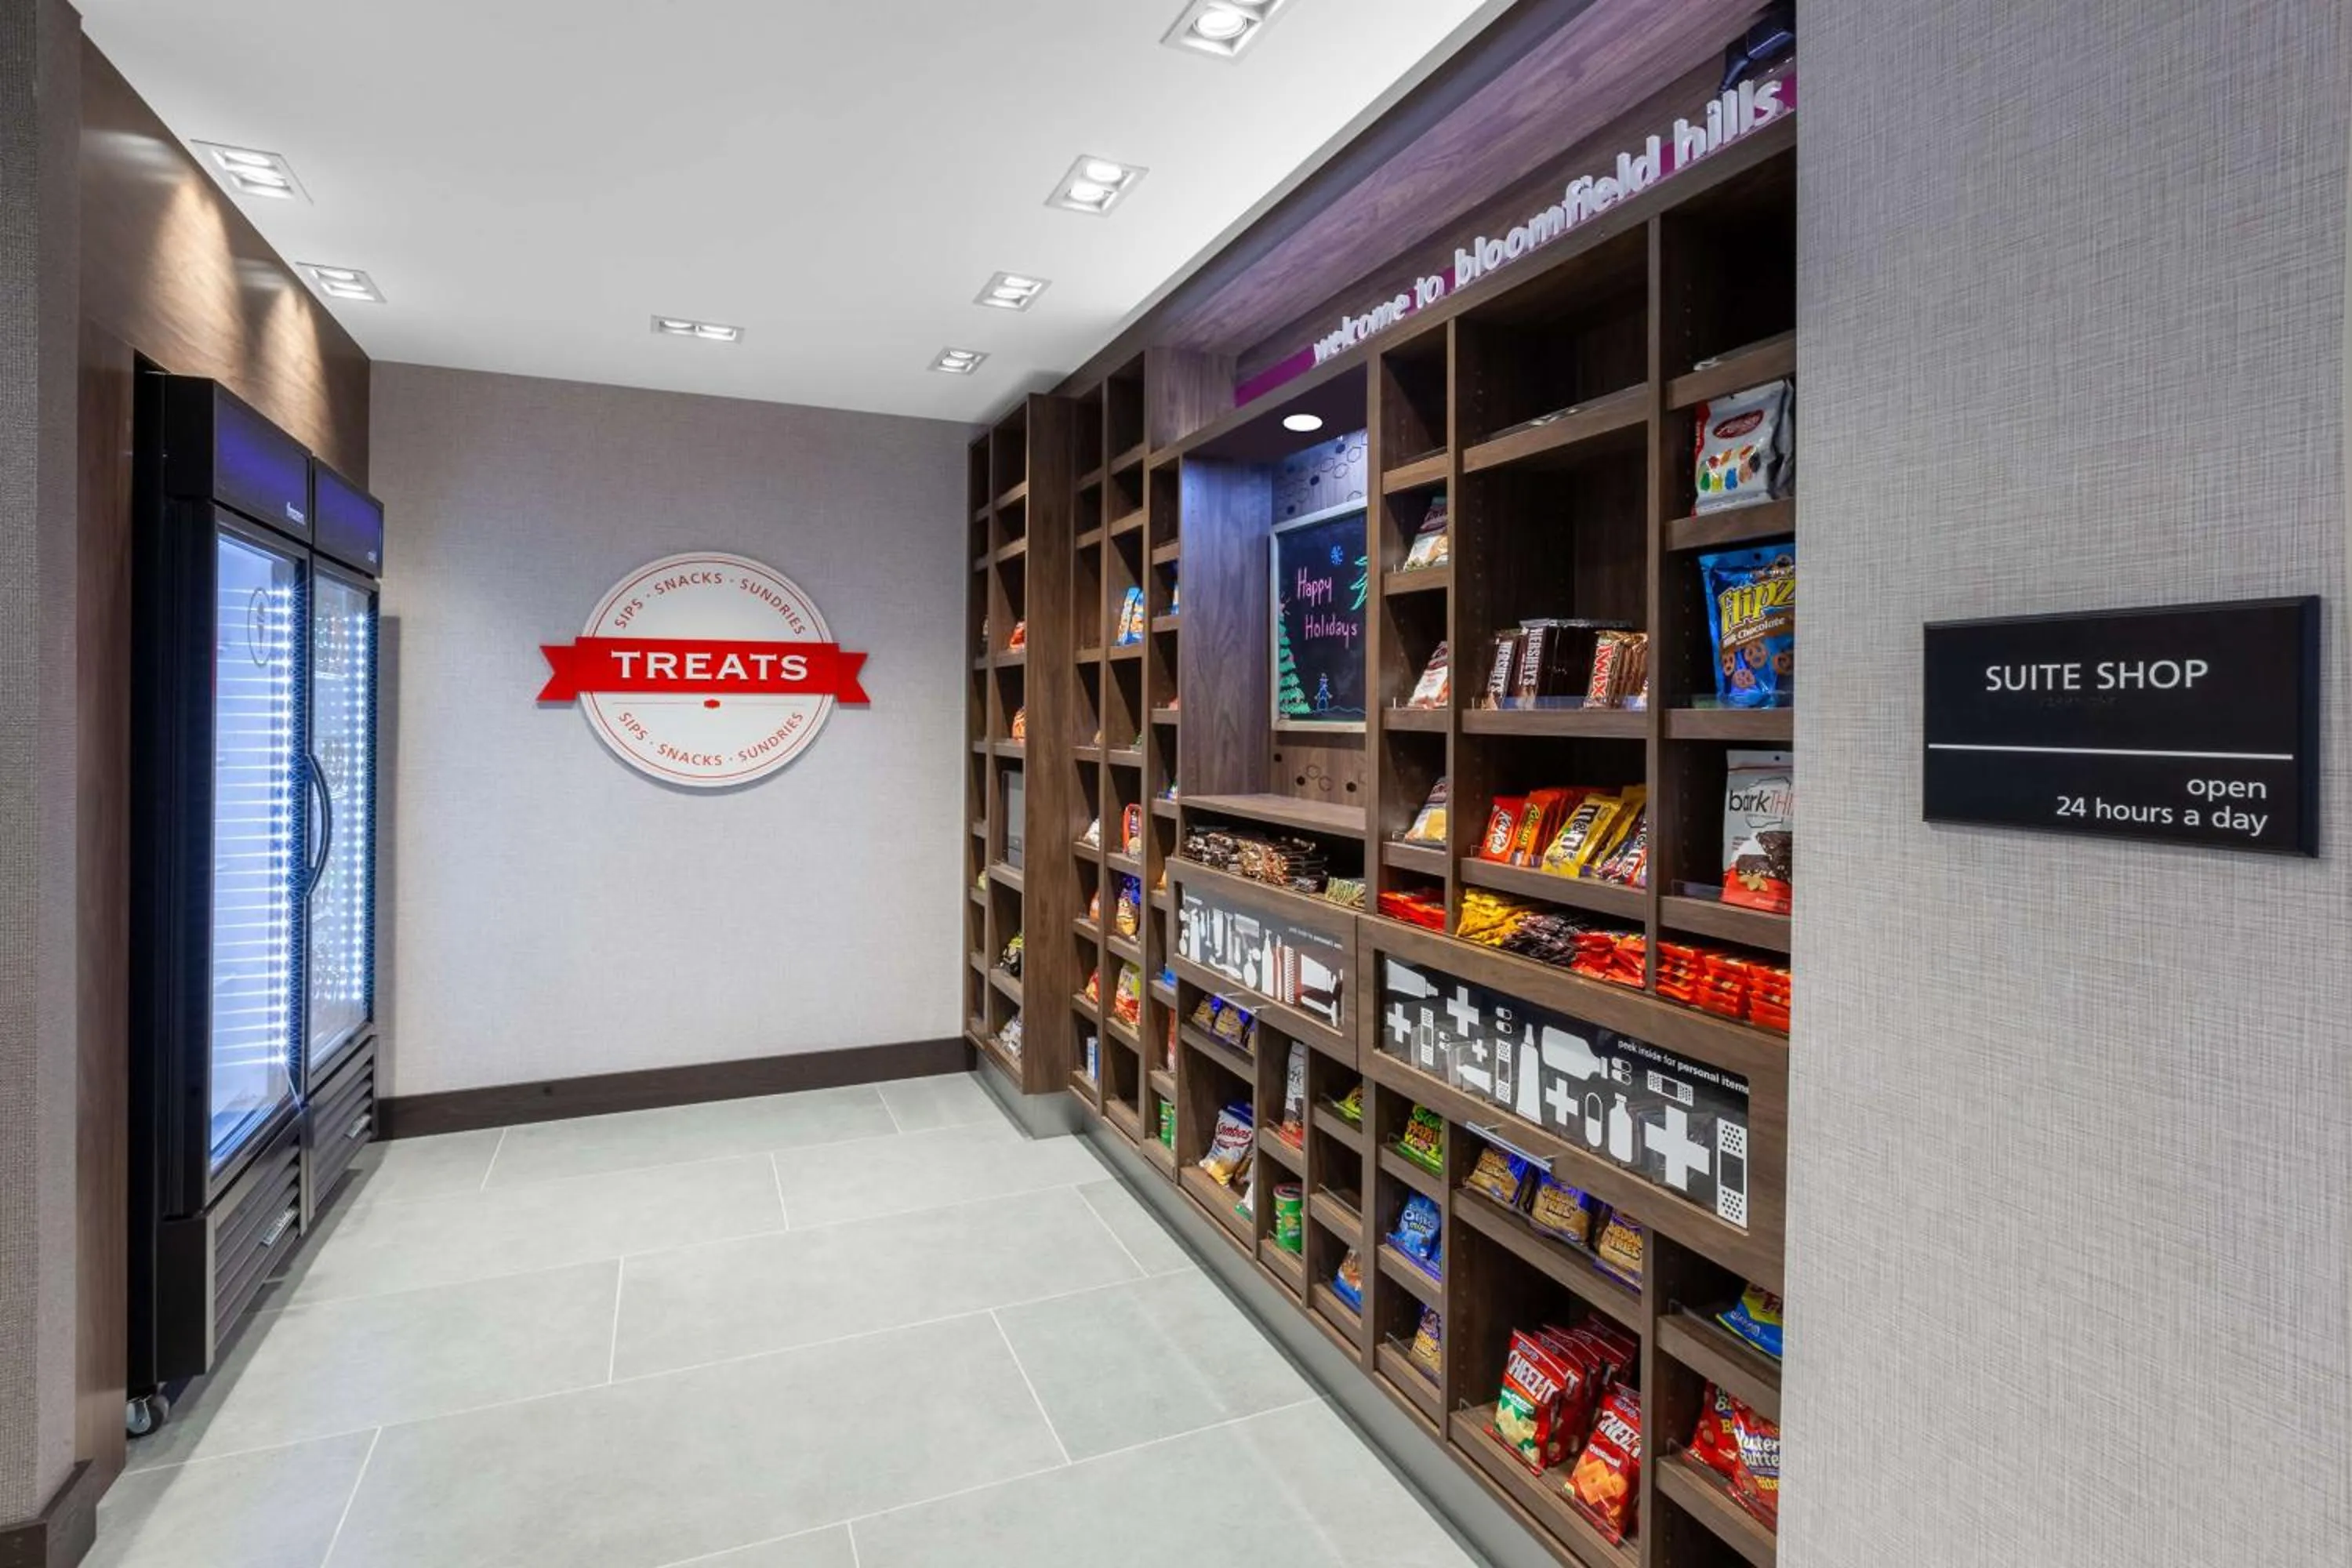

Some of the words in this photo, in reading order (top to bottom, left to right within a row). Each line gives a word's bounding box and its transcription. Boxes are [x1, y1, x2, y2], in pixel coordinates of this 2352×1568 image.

[1312, 292, 1410, 365] welcome
[1414, 274, 1445, 309] to
[1454, 134, 1662, 289] bloomfield
[1672, 79, 1783, 171] hills
[614, 597, 644, 630] SIPS
[654, 572, 723, 596] SNACKS
[739, 578, 806, 636] SUNDRIES
[1297, 567, 1333, 608] Happy
[1305, 613, 1359, 649] Holidays
[610, 650, 809, 681] TREATS
[1985, 662, 2082, 691] SUITE
[2096, 659, 2209, 691] SHOP
[618, 712, 648, 742] SIPS
[656, 742, 723, 767] SNACKS
[737, 711, 804, 763] SUNDRIES
[1729, 789, 1794, 815] barkTHI
[2187, 779, 2267, 802] open
[2056, 796, 2086, 818] 24
[2095, 797, 2174, 826] hours
[2183, 809, 2201, 827] a
[2212, 805, 2269, 837] day
[1617, 1040, 1638, 1053] peek
[1638, 1047, 1662, 1062] inside
[1663, 1054, 1676, 1067] for
[1677, 1061, 1720, 1083] personal
[1740, 1450, 1780, 1468] Butte
